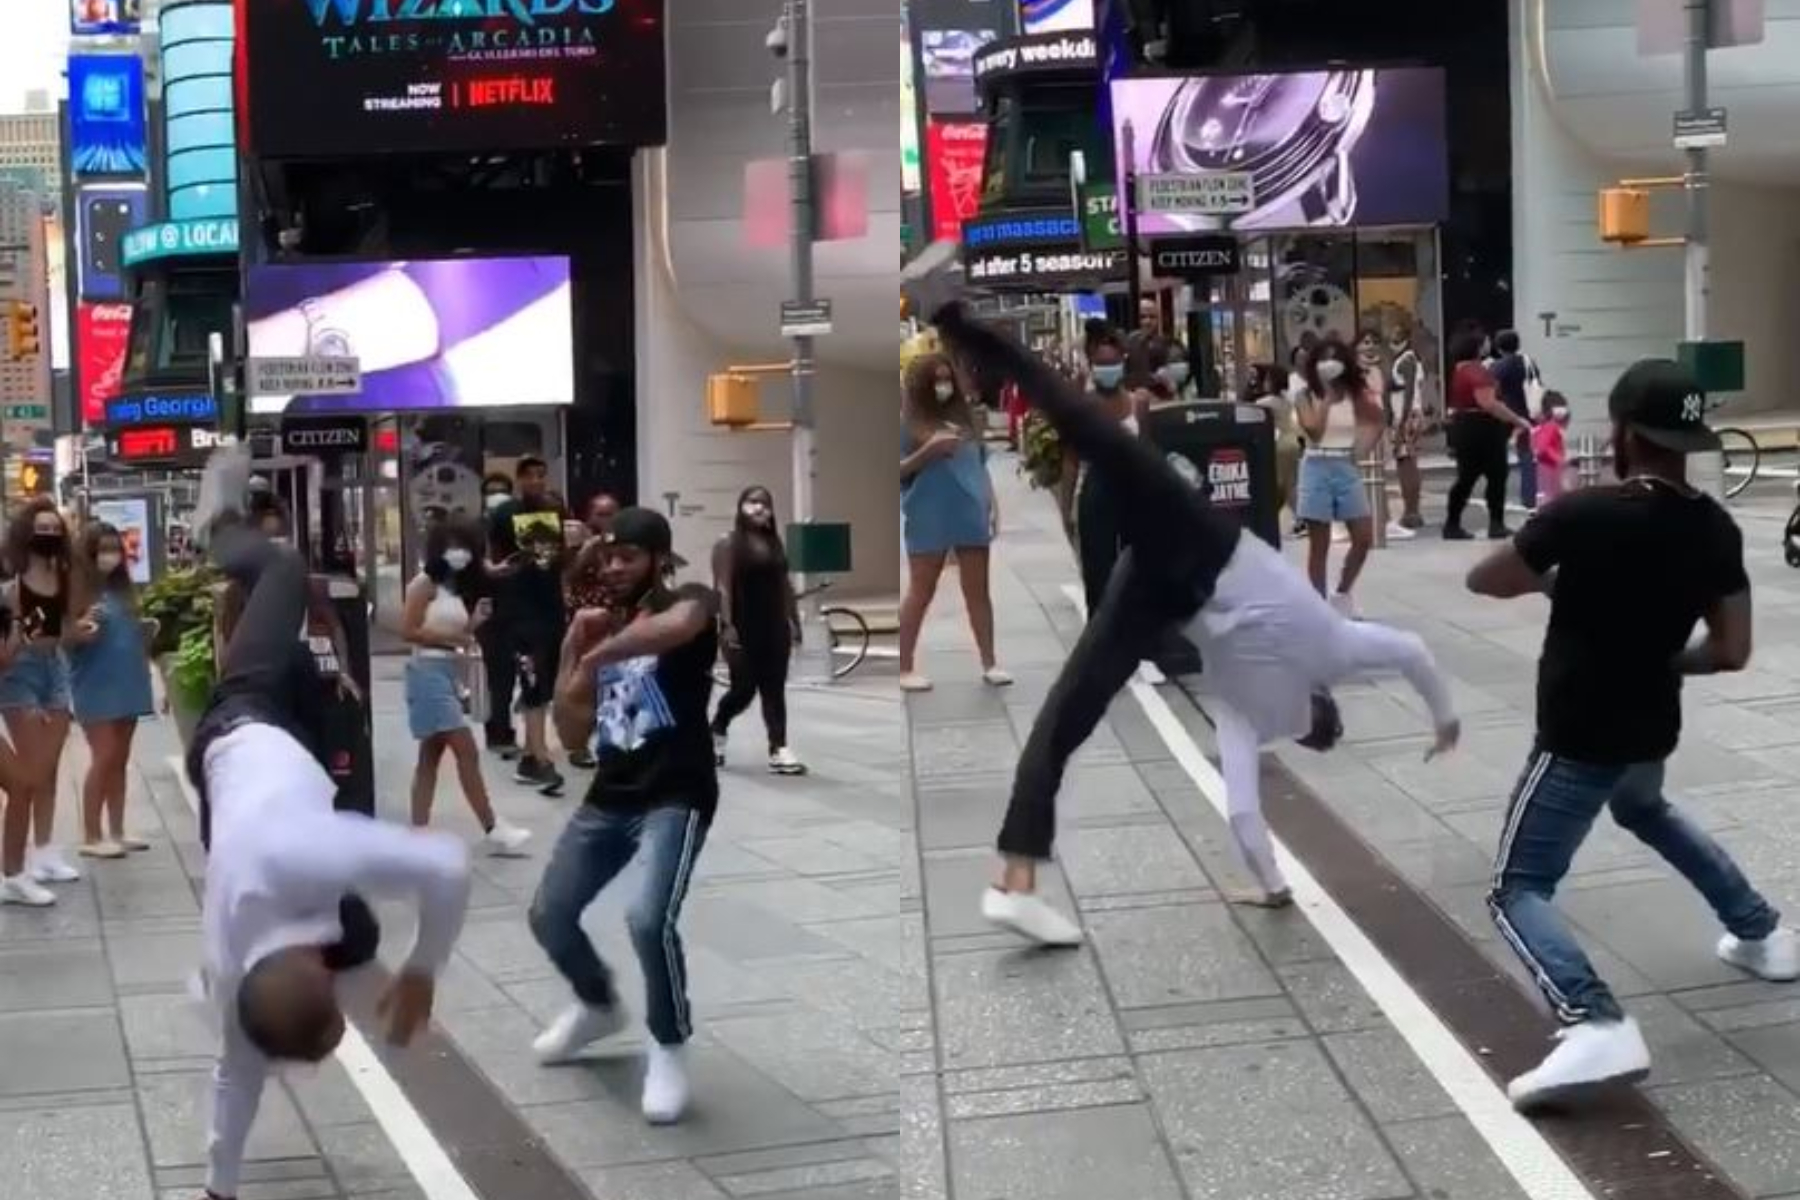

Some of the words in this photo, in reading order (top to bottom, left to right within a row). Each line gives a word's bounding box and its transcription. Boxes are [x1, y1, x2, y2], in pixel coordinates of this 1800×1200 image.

[322, 33, 418, 58] TALES
[451, 27, 595, 50] ARCADIA
[407, 82, 442, 95] NOW
[469, 78, 554, 106] NETFLIX
[363, 95, 442, 110] STREAMING
[1020, 252, 1032, 273] 5
[1158, 251, 1231, 267] CITIZEN
[288, 428, 358, 444] CITIZEN
